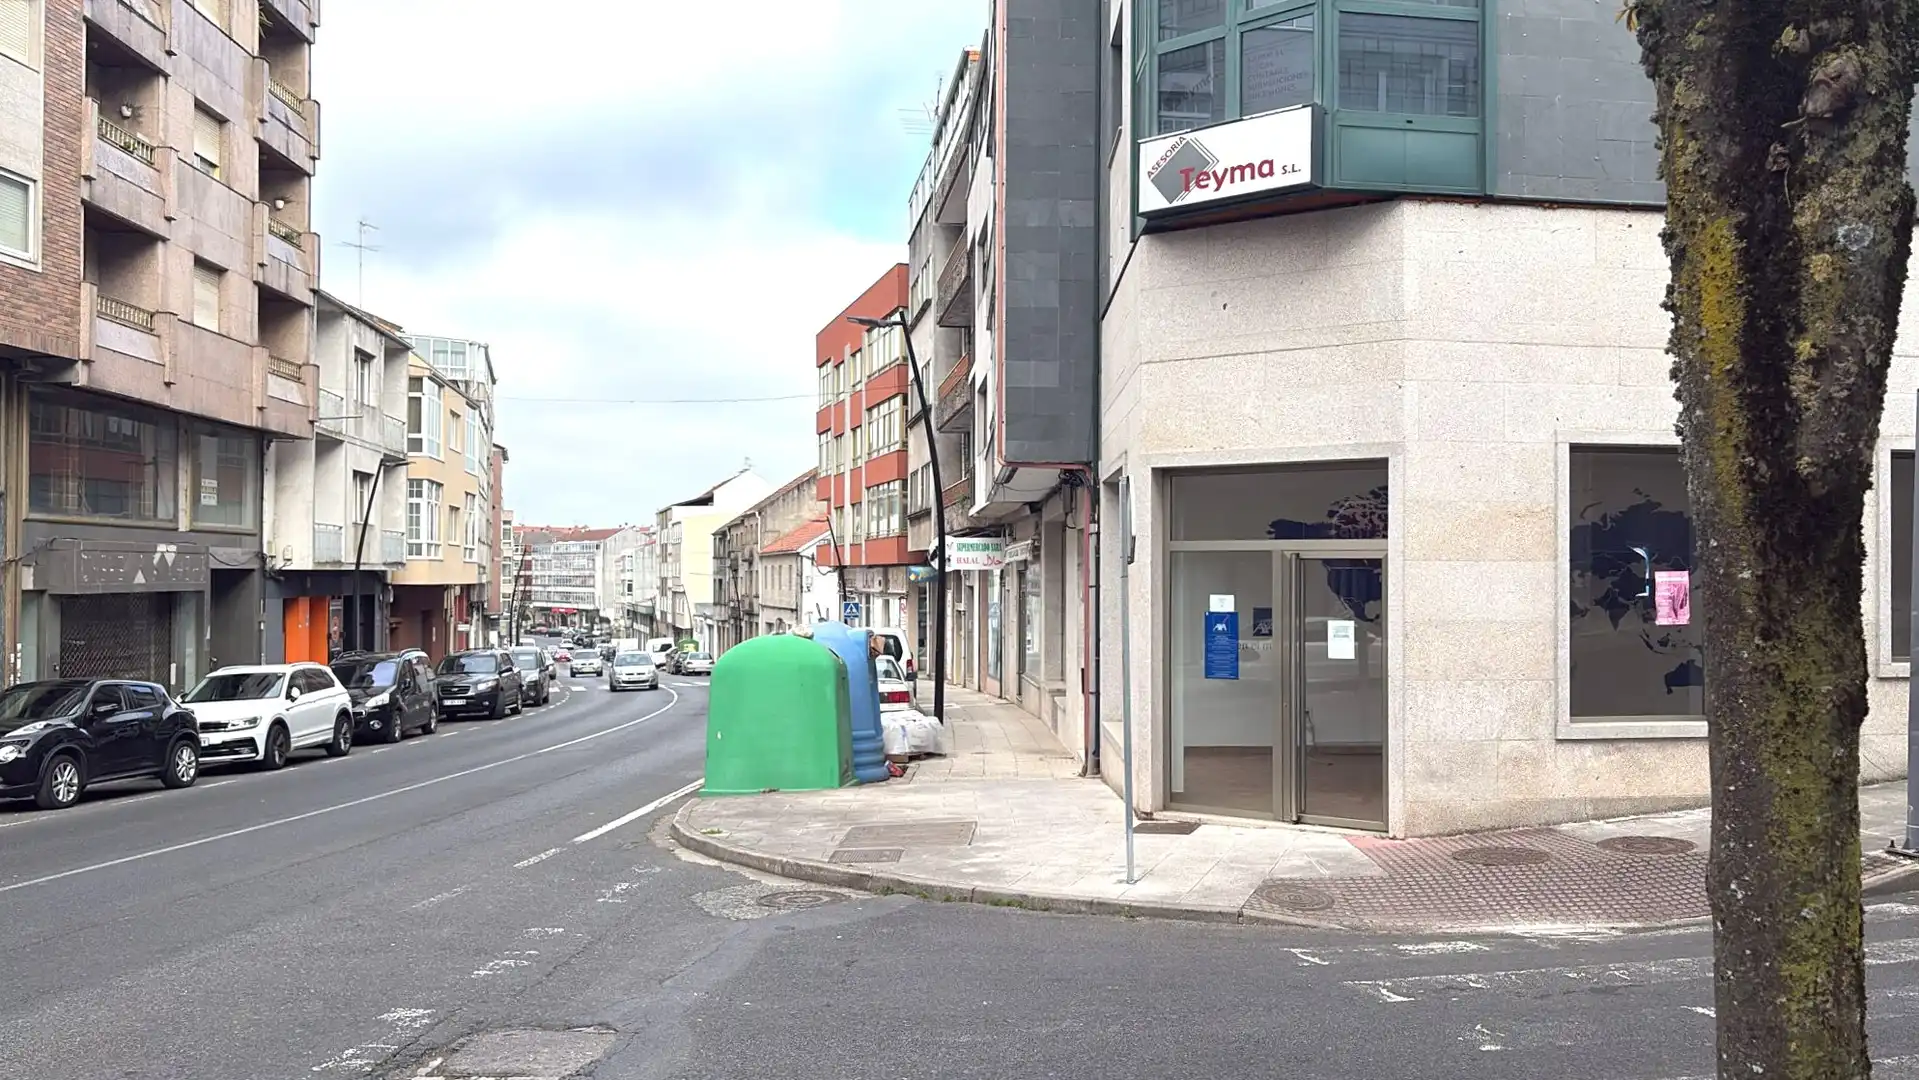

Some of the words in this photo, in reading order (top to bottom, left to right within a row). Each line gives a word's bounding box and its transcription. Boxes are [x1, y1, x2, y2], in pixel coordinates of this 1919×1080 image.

[1147, 136, 1187, 178] ASESORIA
[1179, 158, 1275, 193] Teyma
[956, 557, 980, 565] HALAL
[982, 554, 1003, 567] حلال
